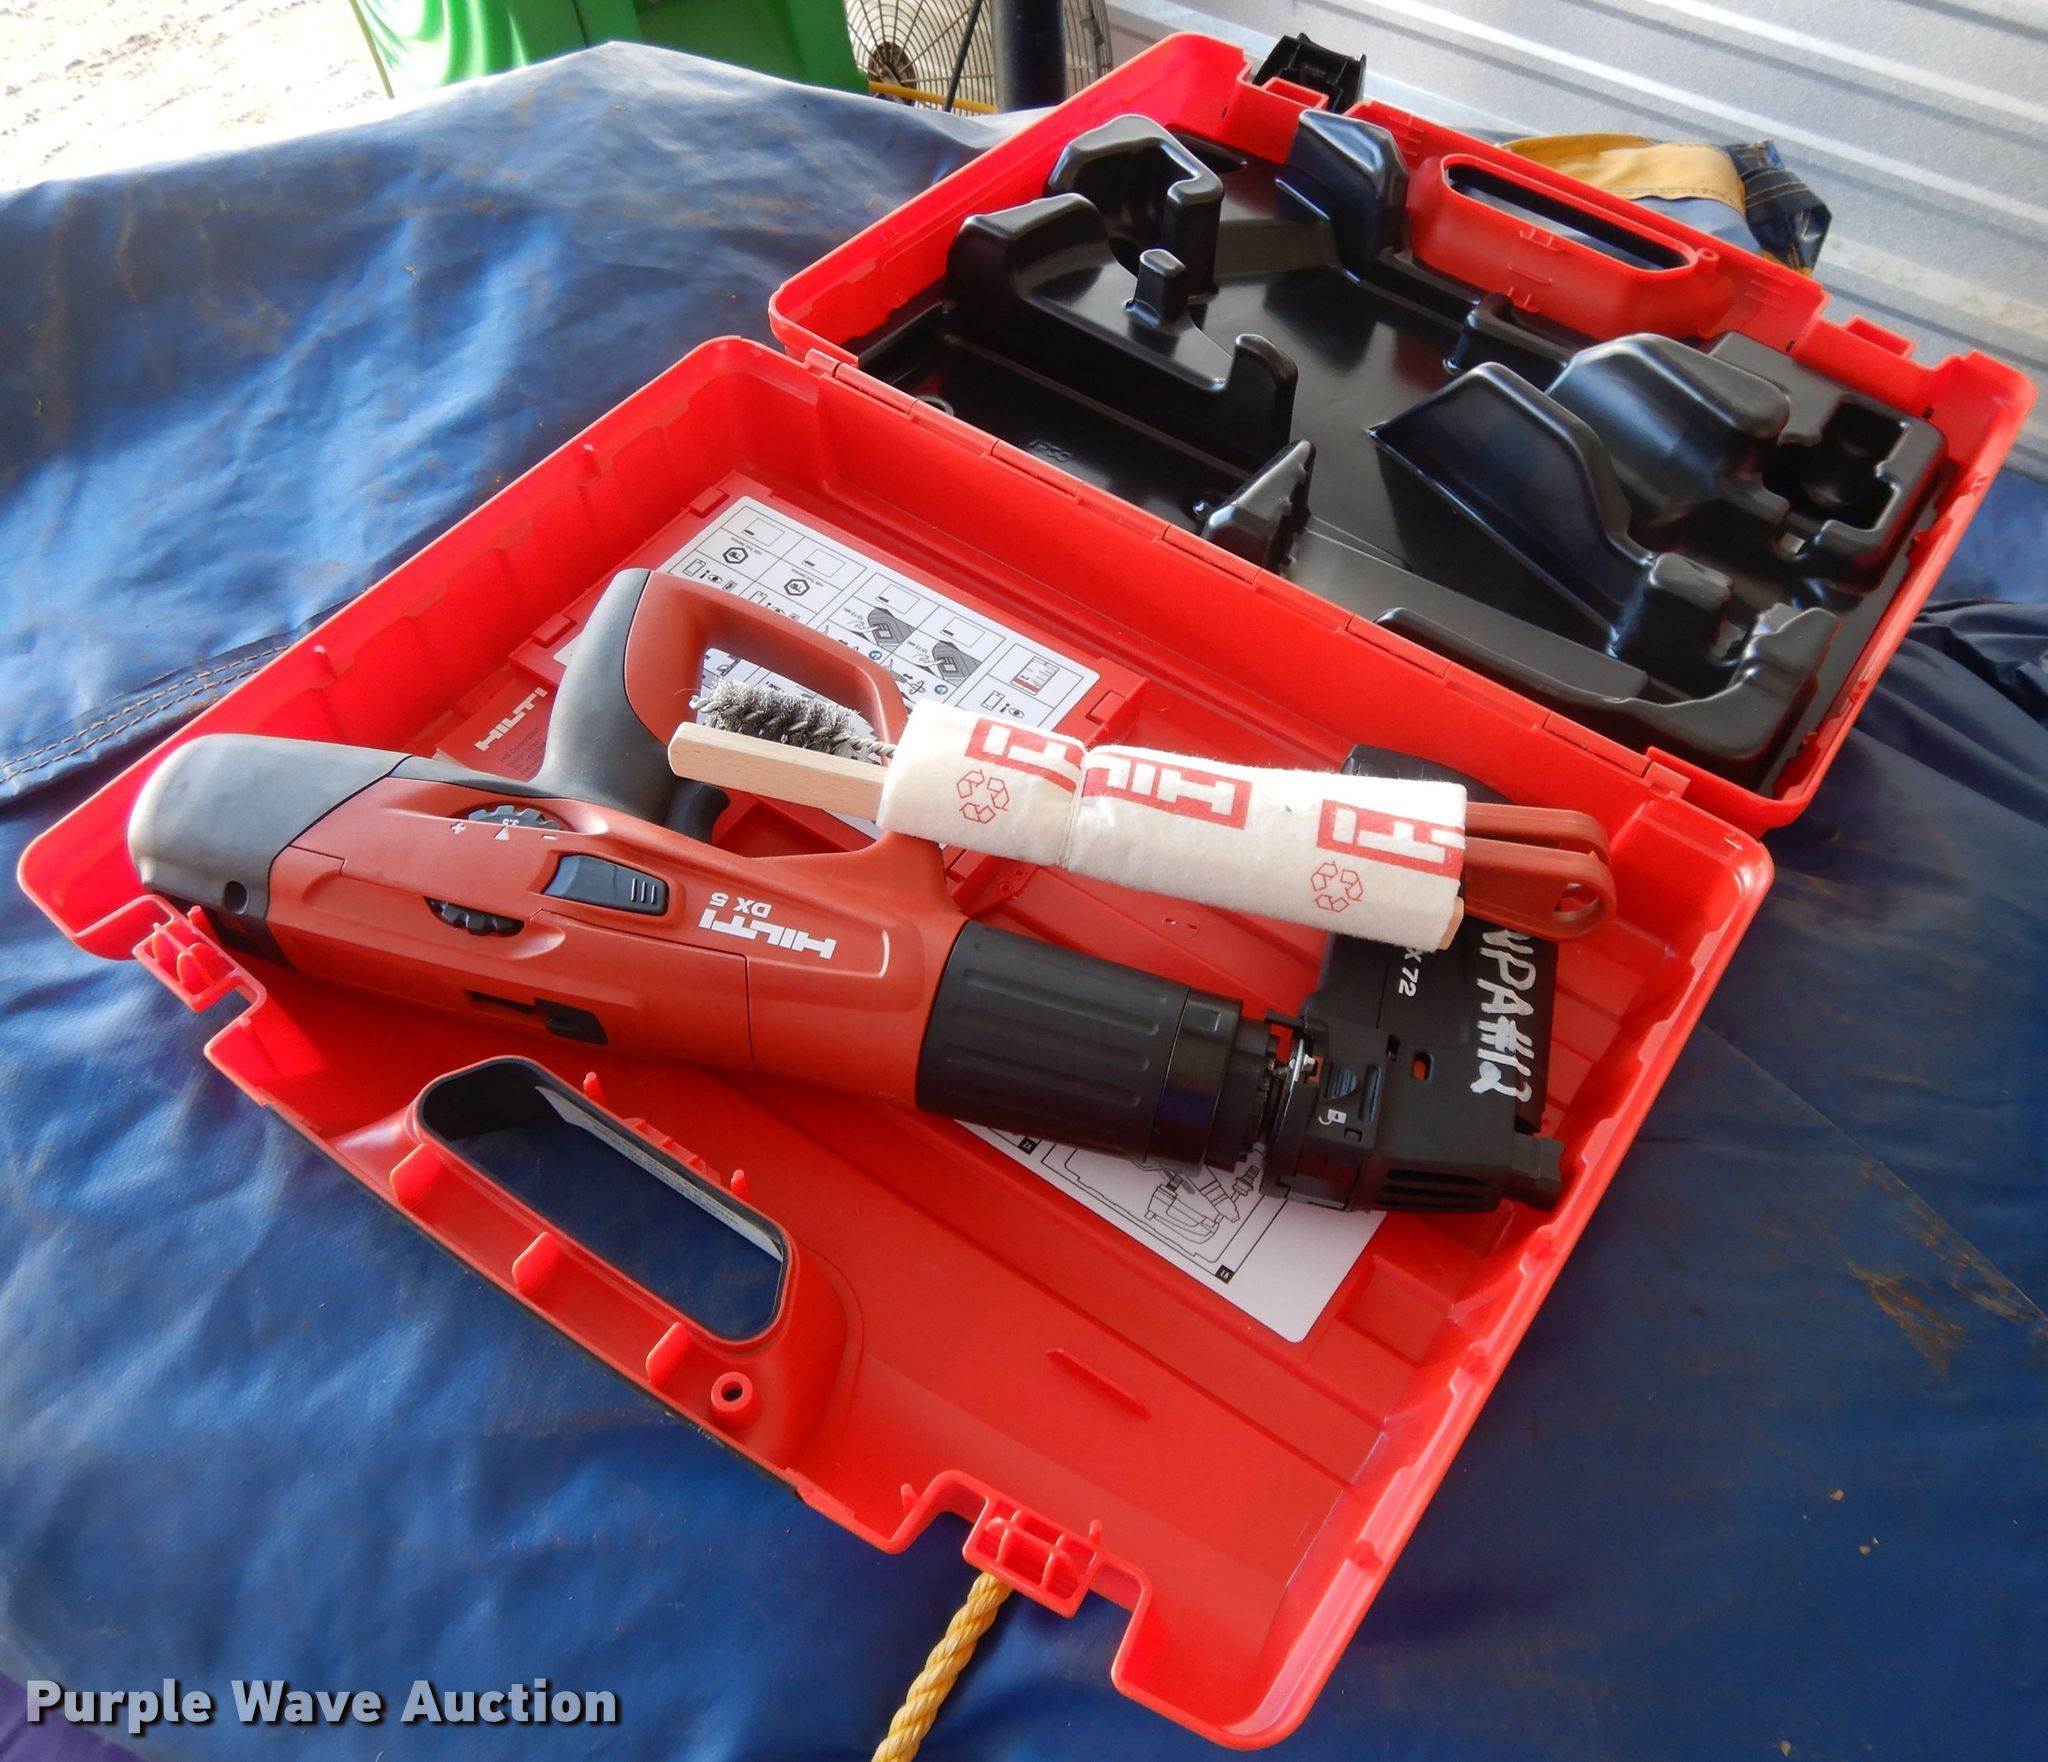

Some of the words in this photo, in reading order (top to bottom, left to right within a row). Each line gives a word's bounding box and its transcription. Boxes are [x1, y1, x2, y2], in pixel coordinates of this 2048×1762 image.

[474, 687, 548, 752] HILTI
[709, 892, 729, 907] 5
[733, 897, 772, 919] DX
[699, 908, 837, 960] HILTI
[1398, 966, 1420, 997] 72
